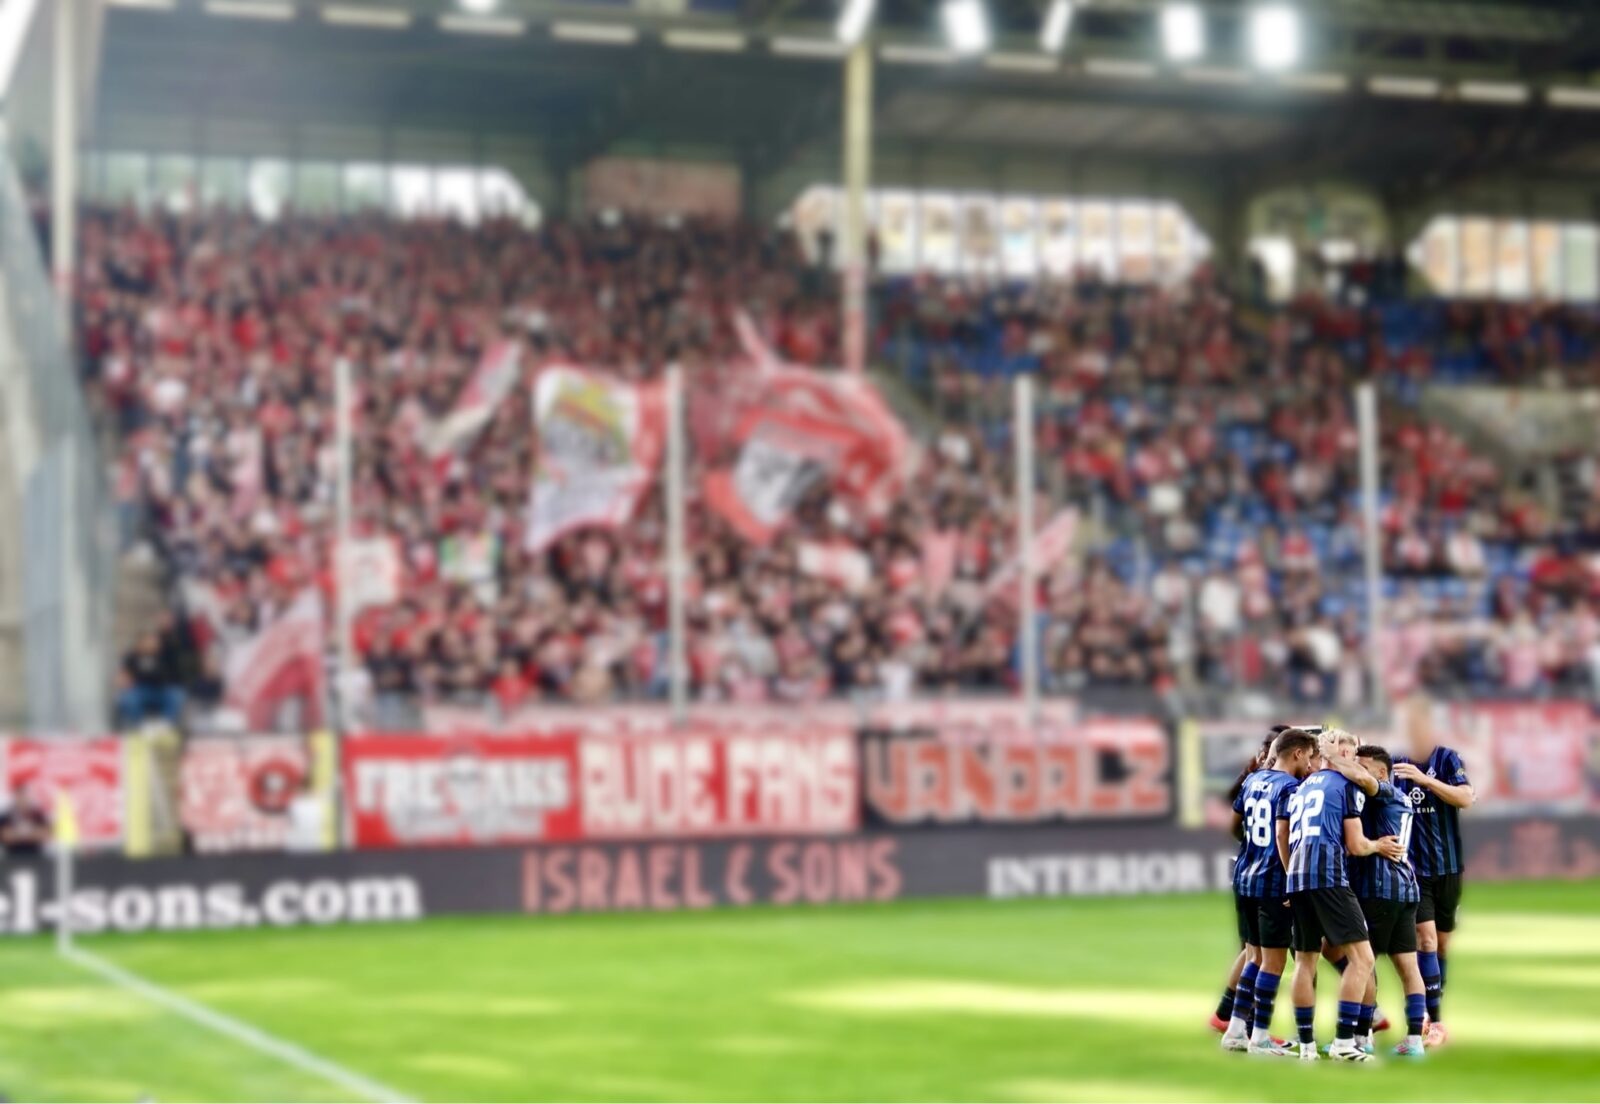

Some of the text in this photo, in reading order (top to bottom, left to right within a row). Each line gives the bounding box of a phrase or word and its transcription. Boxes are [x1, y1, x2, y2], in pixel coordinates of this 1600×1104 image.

[582, 732, 857, 833] RUDE FANS
[1244, 797, 1272, 847] 38
[1287, 789, 1325, 845] 22
[0, 871, 422, 932] l-sons.com
[521, 846, 714, 914] ISRAEL
[767, 836, 903, 904] SONS
[988, 852, 1203, 899] INTERIOR
